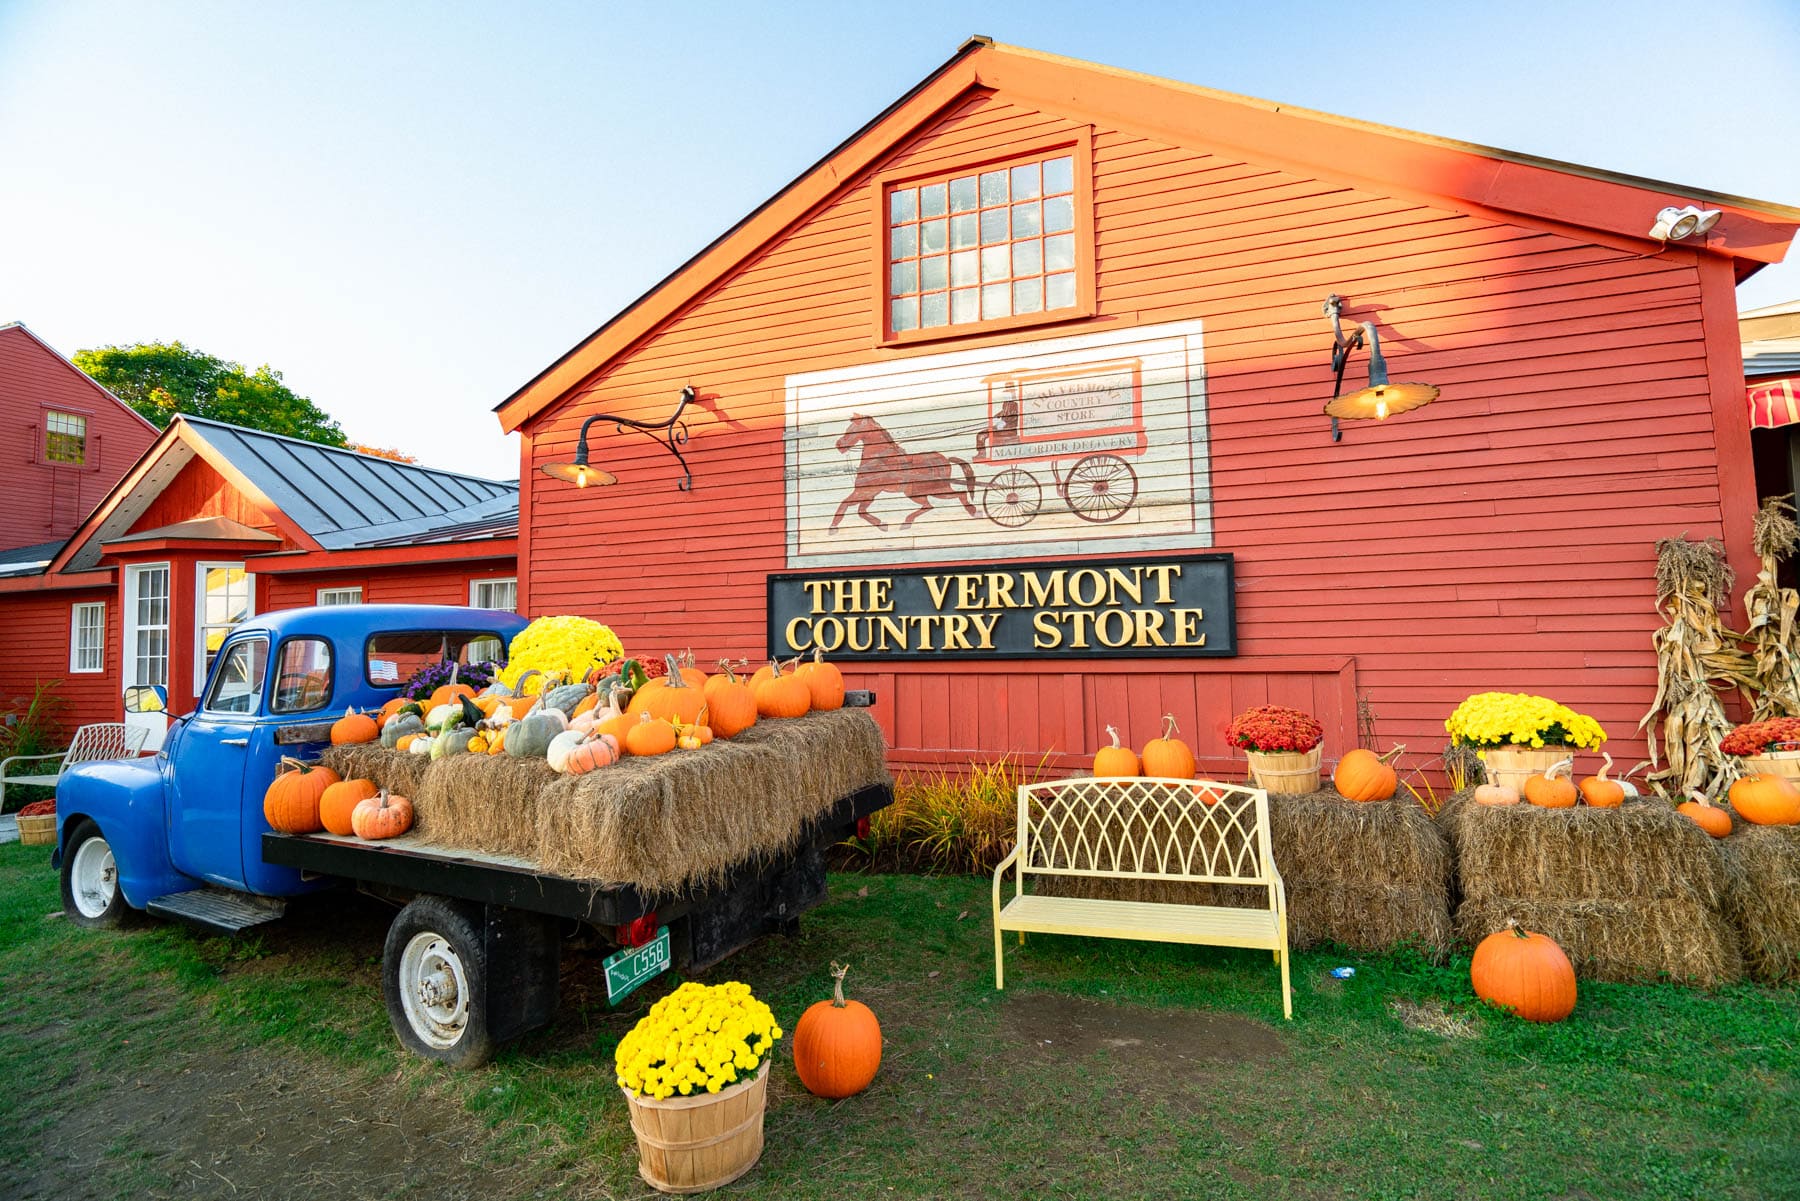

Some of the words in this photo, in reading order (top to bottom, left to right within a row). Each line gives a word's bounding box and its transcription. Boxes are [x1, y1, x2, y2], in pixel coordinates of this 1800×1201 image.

[1046, 395, 1103, 411] COUNTRY
[1056, 409, 1096, 422] STORE
[993, 445, 1024, 458] MAIL
[1028, 441, 1069, 454] ORDER
[1072, 436, 1133, 451] DELIVERY
[803, 577, 895, 614] THE
[923, 564, 1182, 611] VERMONT
[785, 612, 1003, 651] COUNTRY
[1033, 607, 1206, 649] STORE
[633, 941, 664, 976] C558
